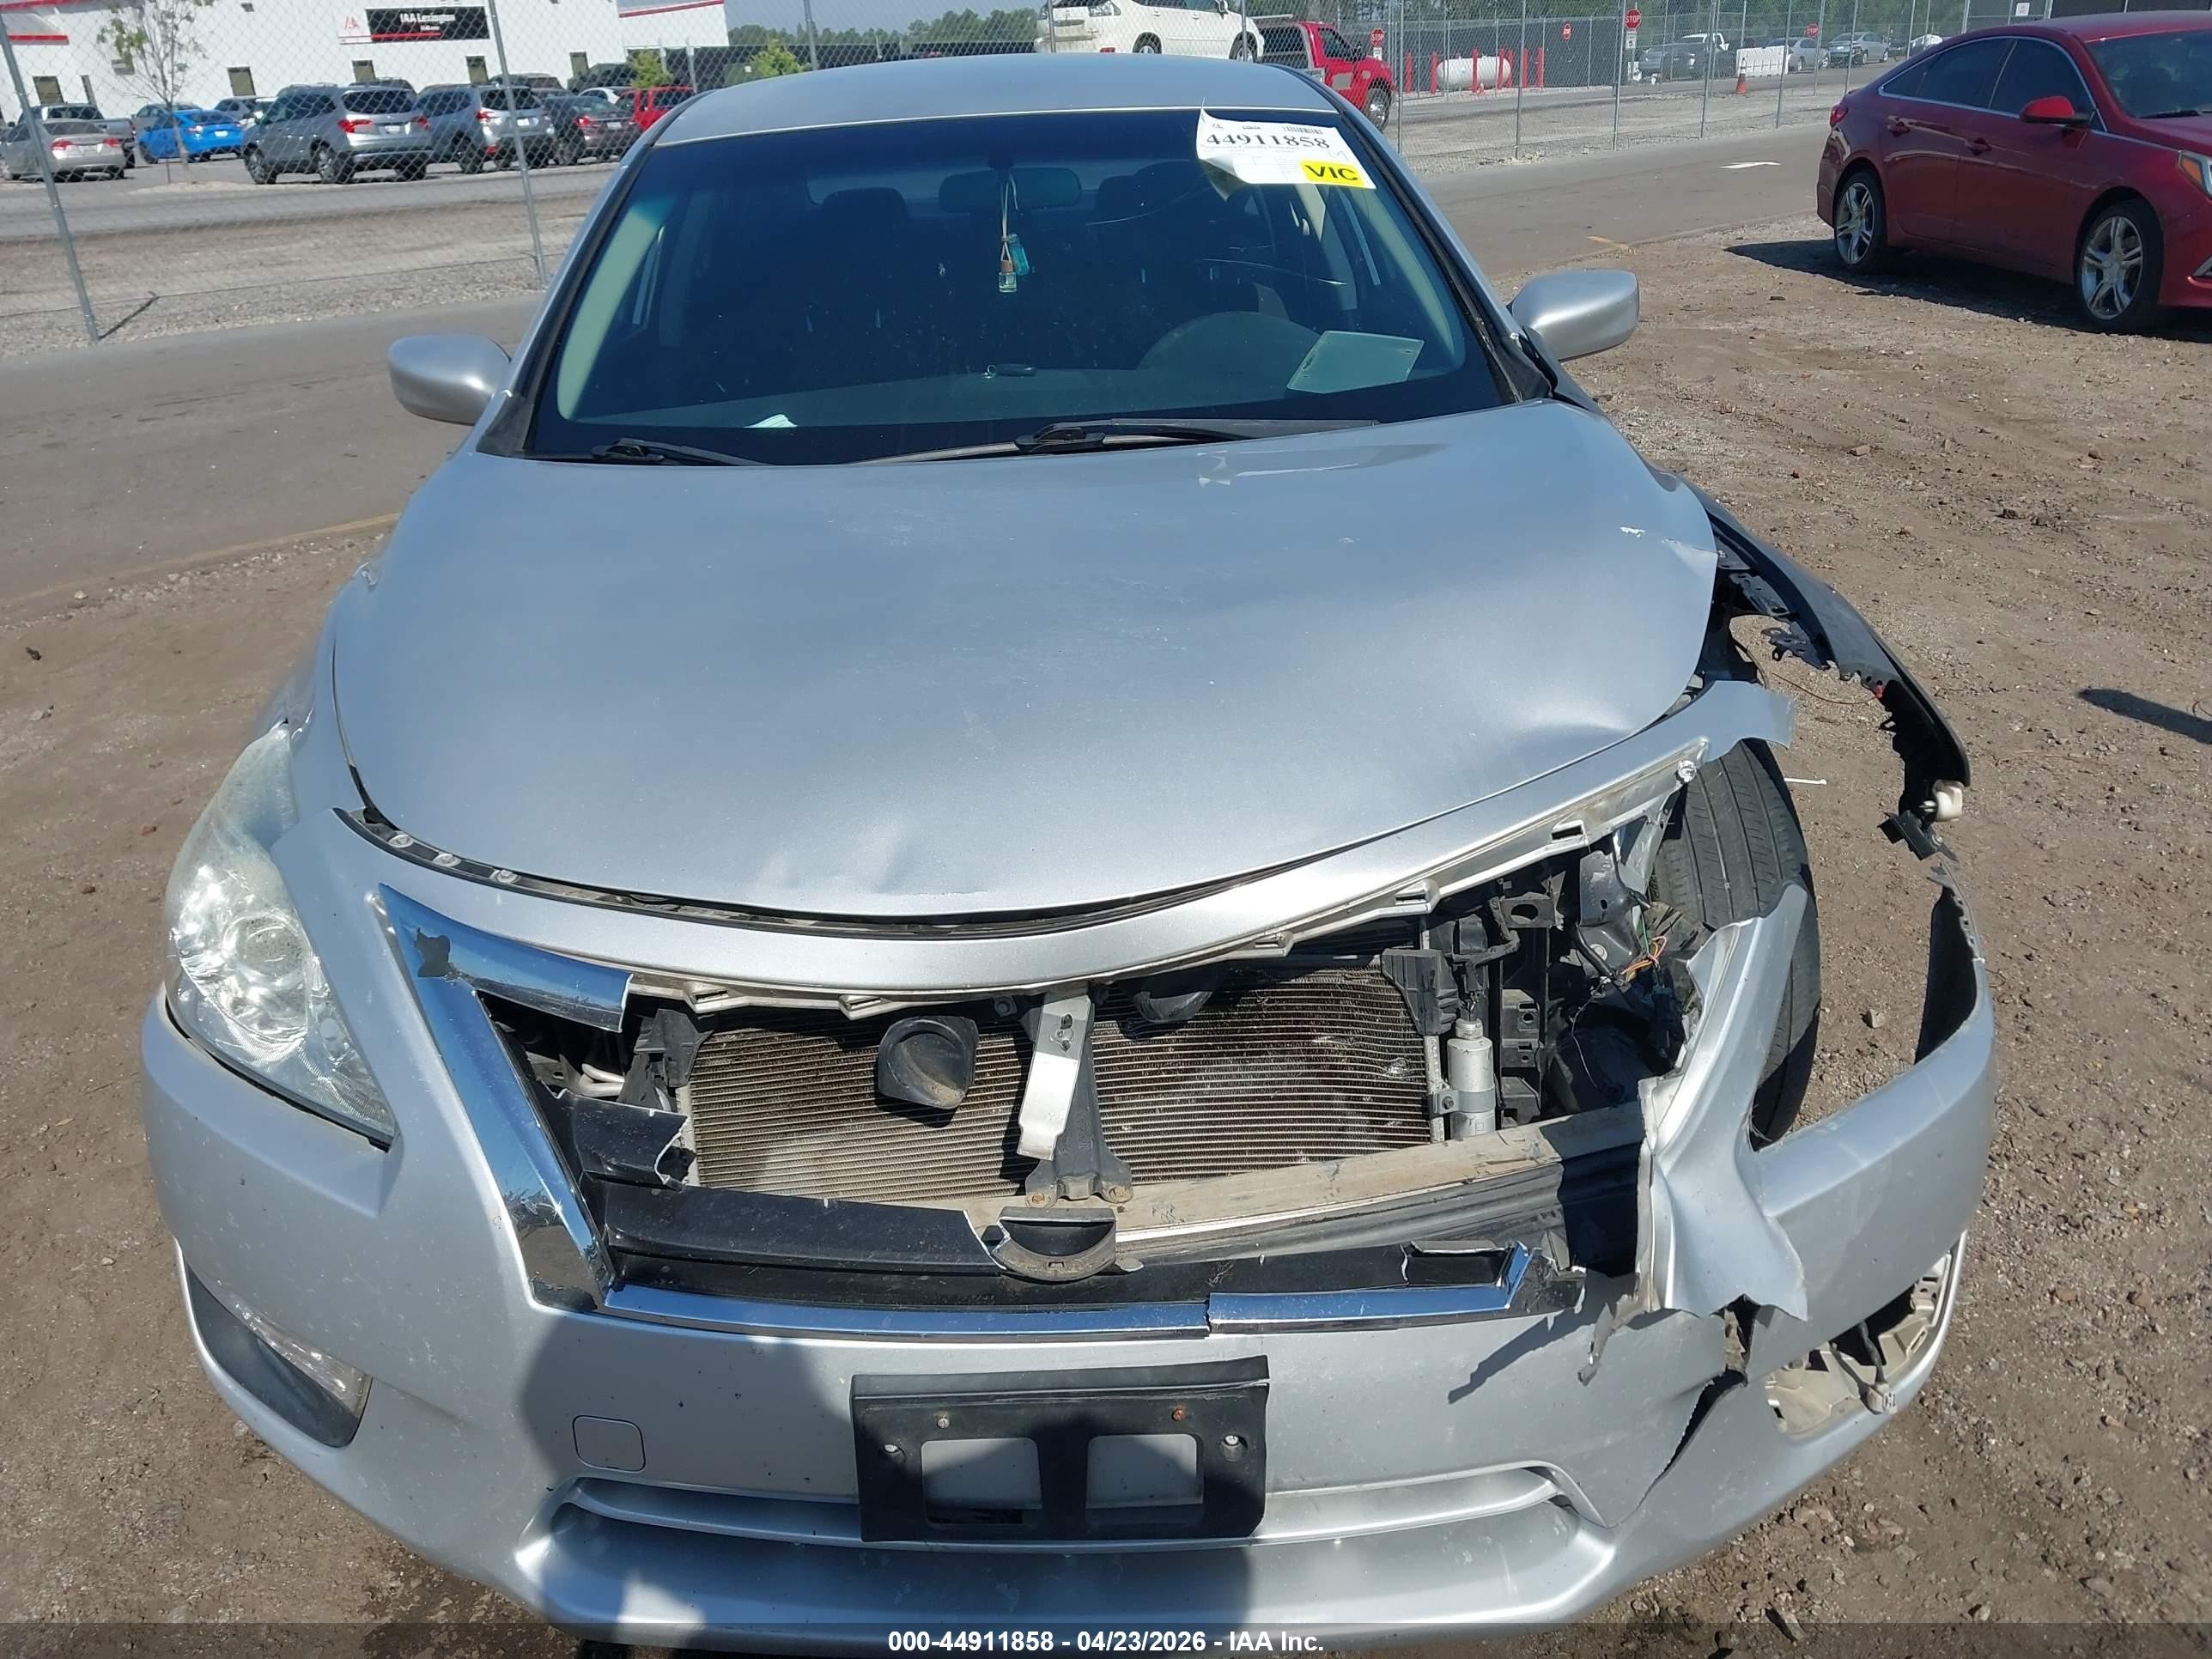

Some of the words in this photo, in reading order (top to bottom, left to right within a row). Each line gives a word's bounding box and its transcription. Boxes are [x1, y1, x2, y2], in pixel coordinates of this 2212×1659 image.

[1625, 15, 1640, 23] STOP
[1206, 133, 1330, 149] 44911858
[1304, 164, 1358, 181] VIC
